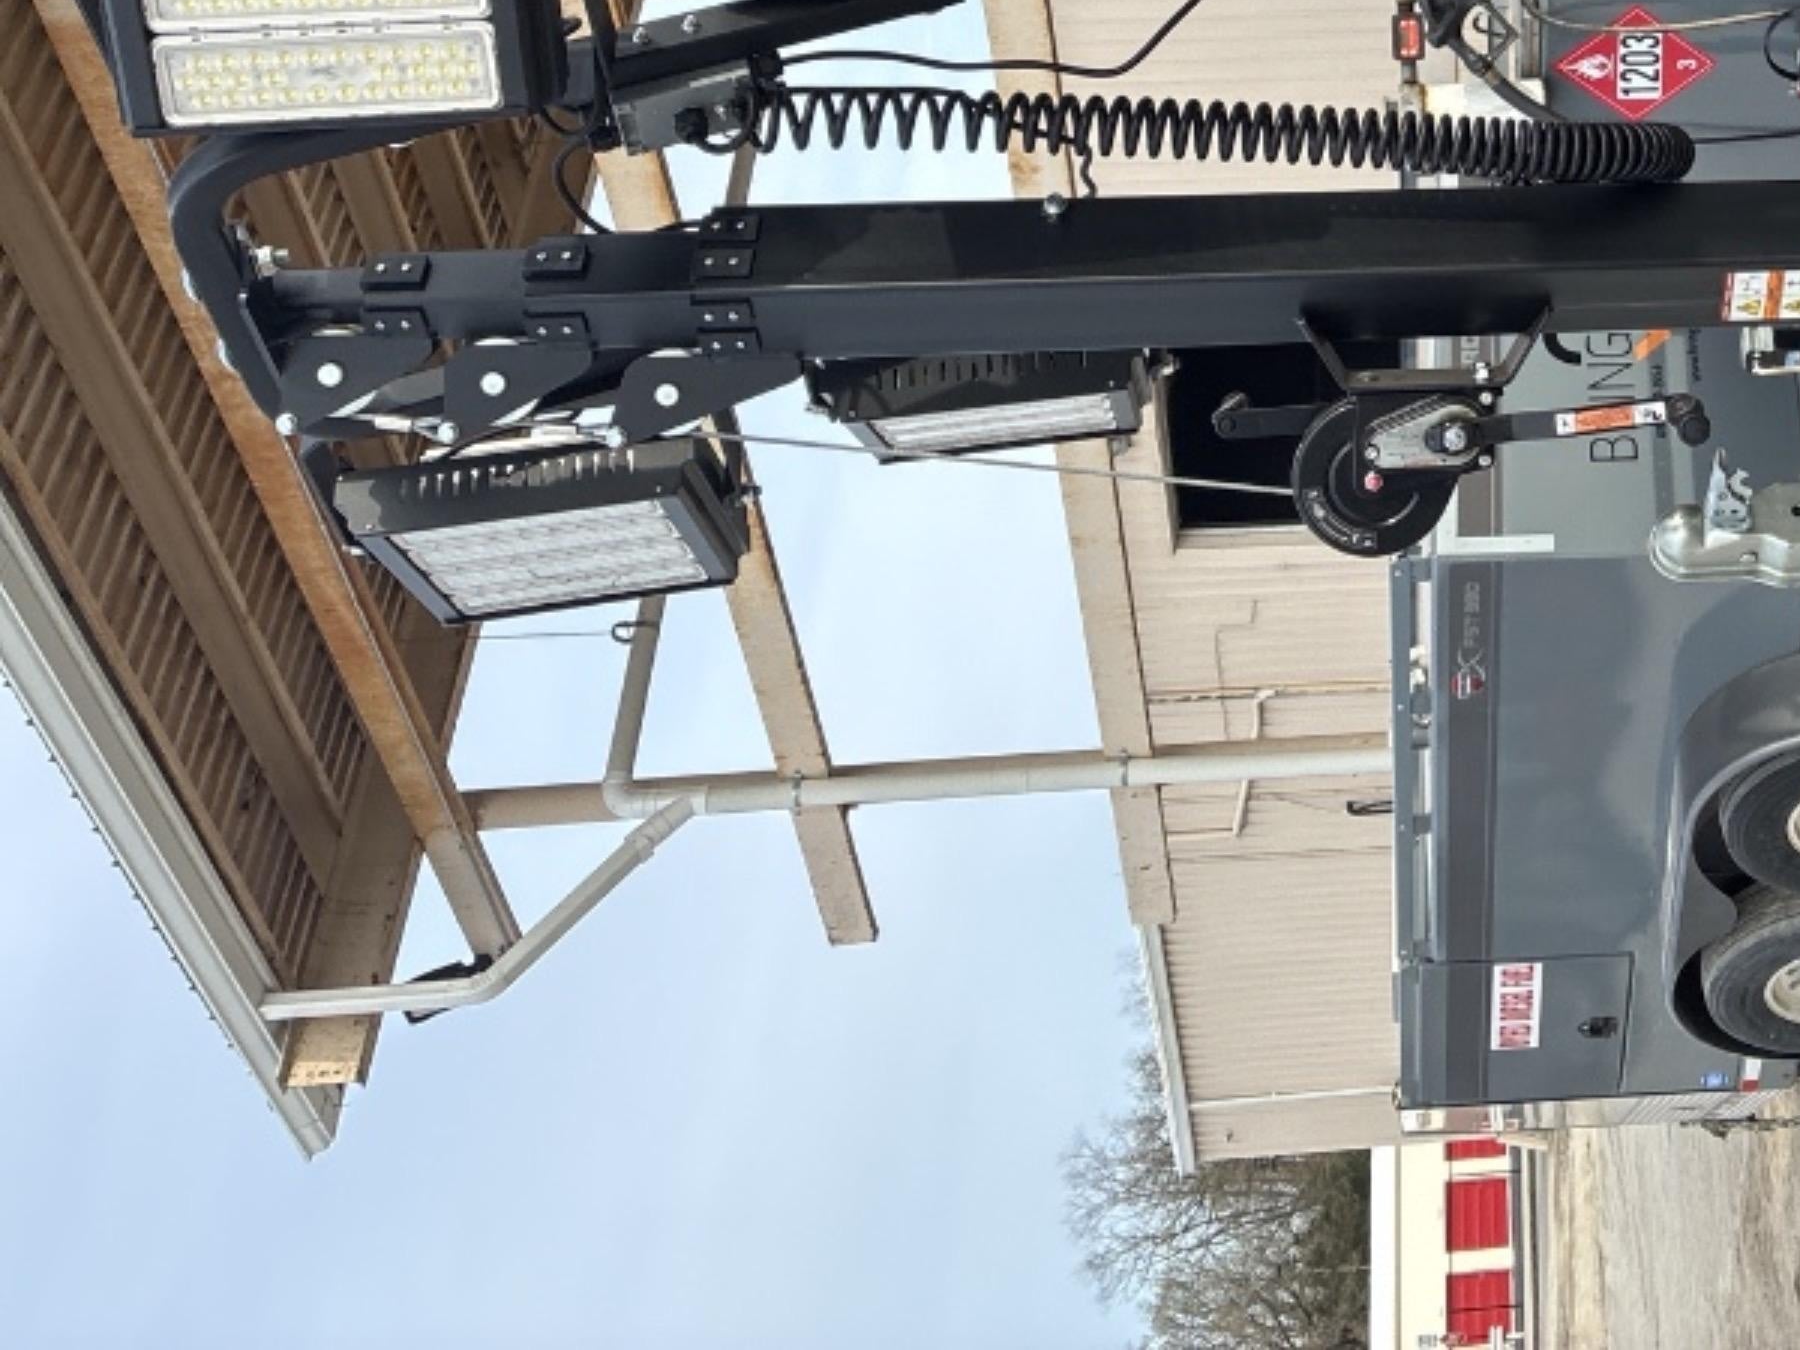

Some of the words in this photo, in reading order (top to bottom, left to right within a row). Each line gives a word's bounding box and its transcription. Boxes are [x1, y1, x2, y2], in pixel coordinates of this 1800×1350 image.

[1619, 34, 1660, 97] 1203
[1676, 58, 1697, 70] 3
[1586, 332, 1639, 463] BING
